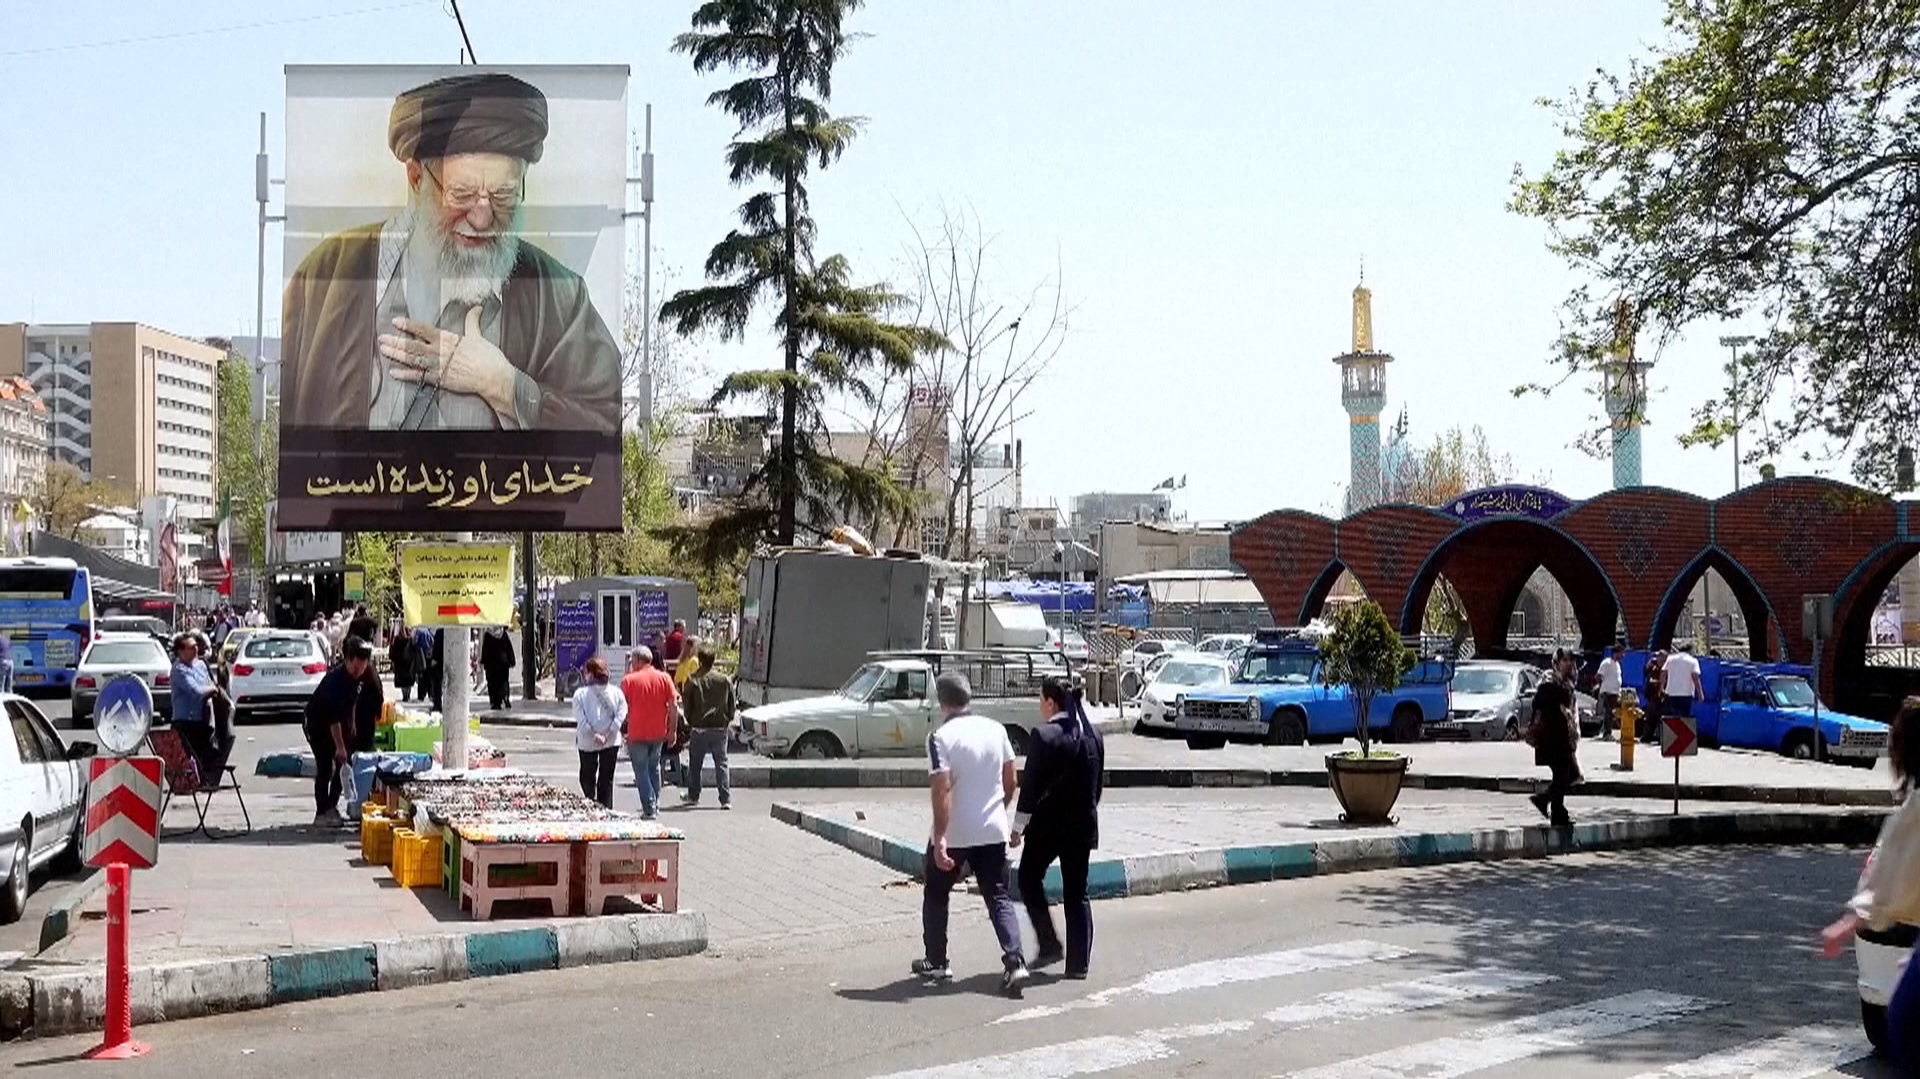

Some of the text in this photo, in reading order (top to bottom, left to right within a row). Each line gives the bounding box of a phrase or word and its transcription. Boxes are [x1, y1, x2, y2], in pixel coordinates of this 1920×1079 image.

[306, 460, 593, 507] خدای او زنده است
